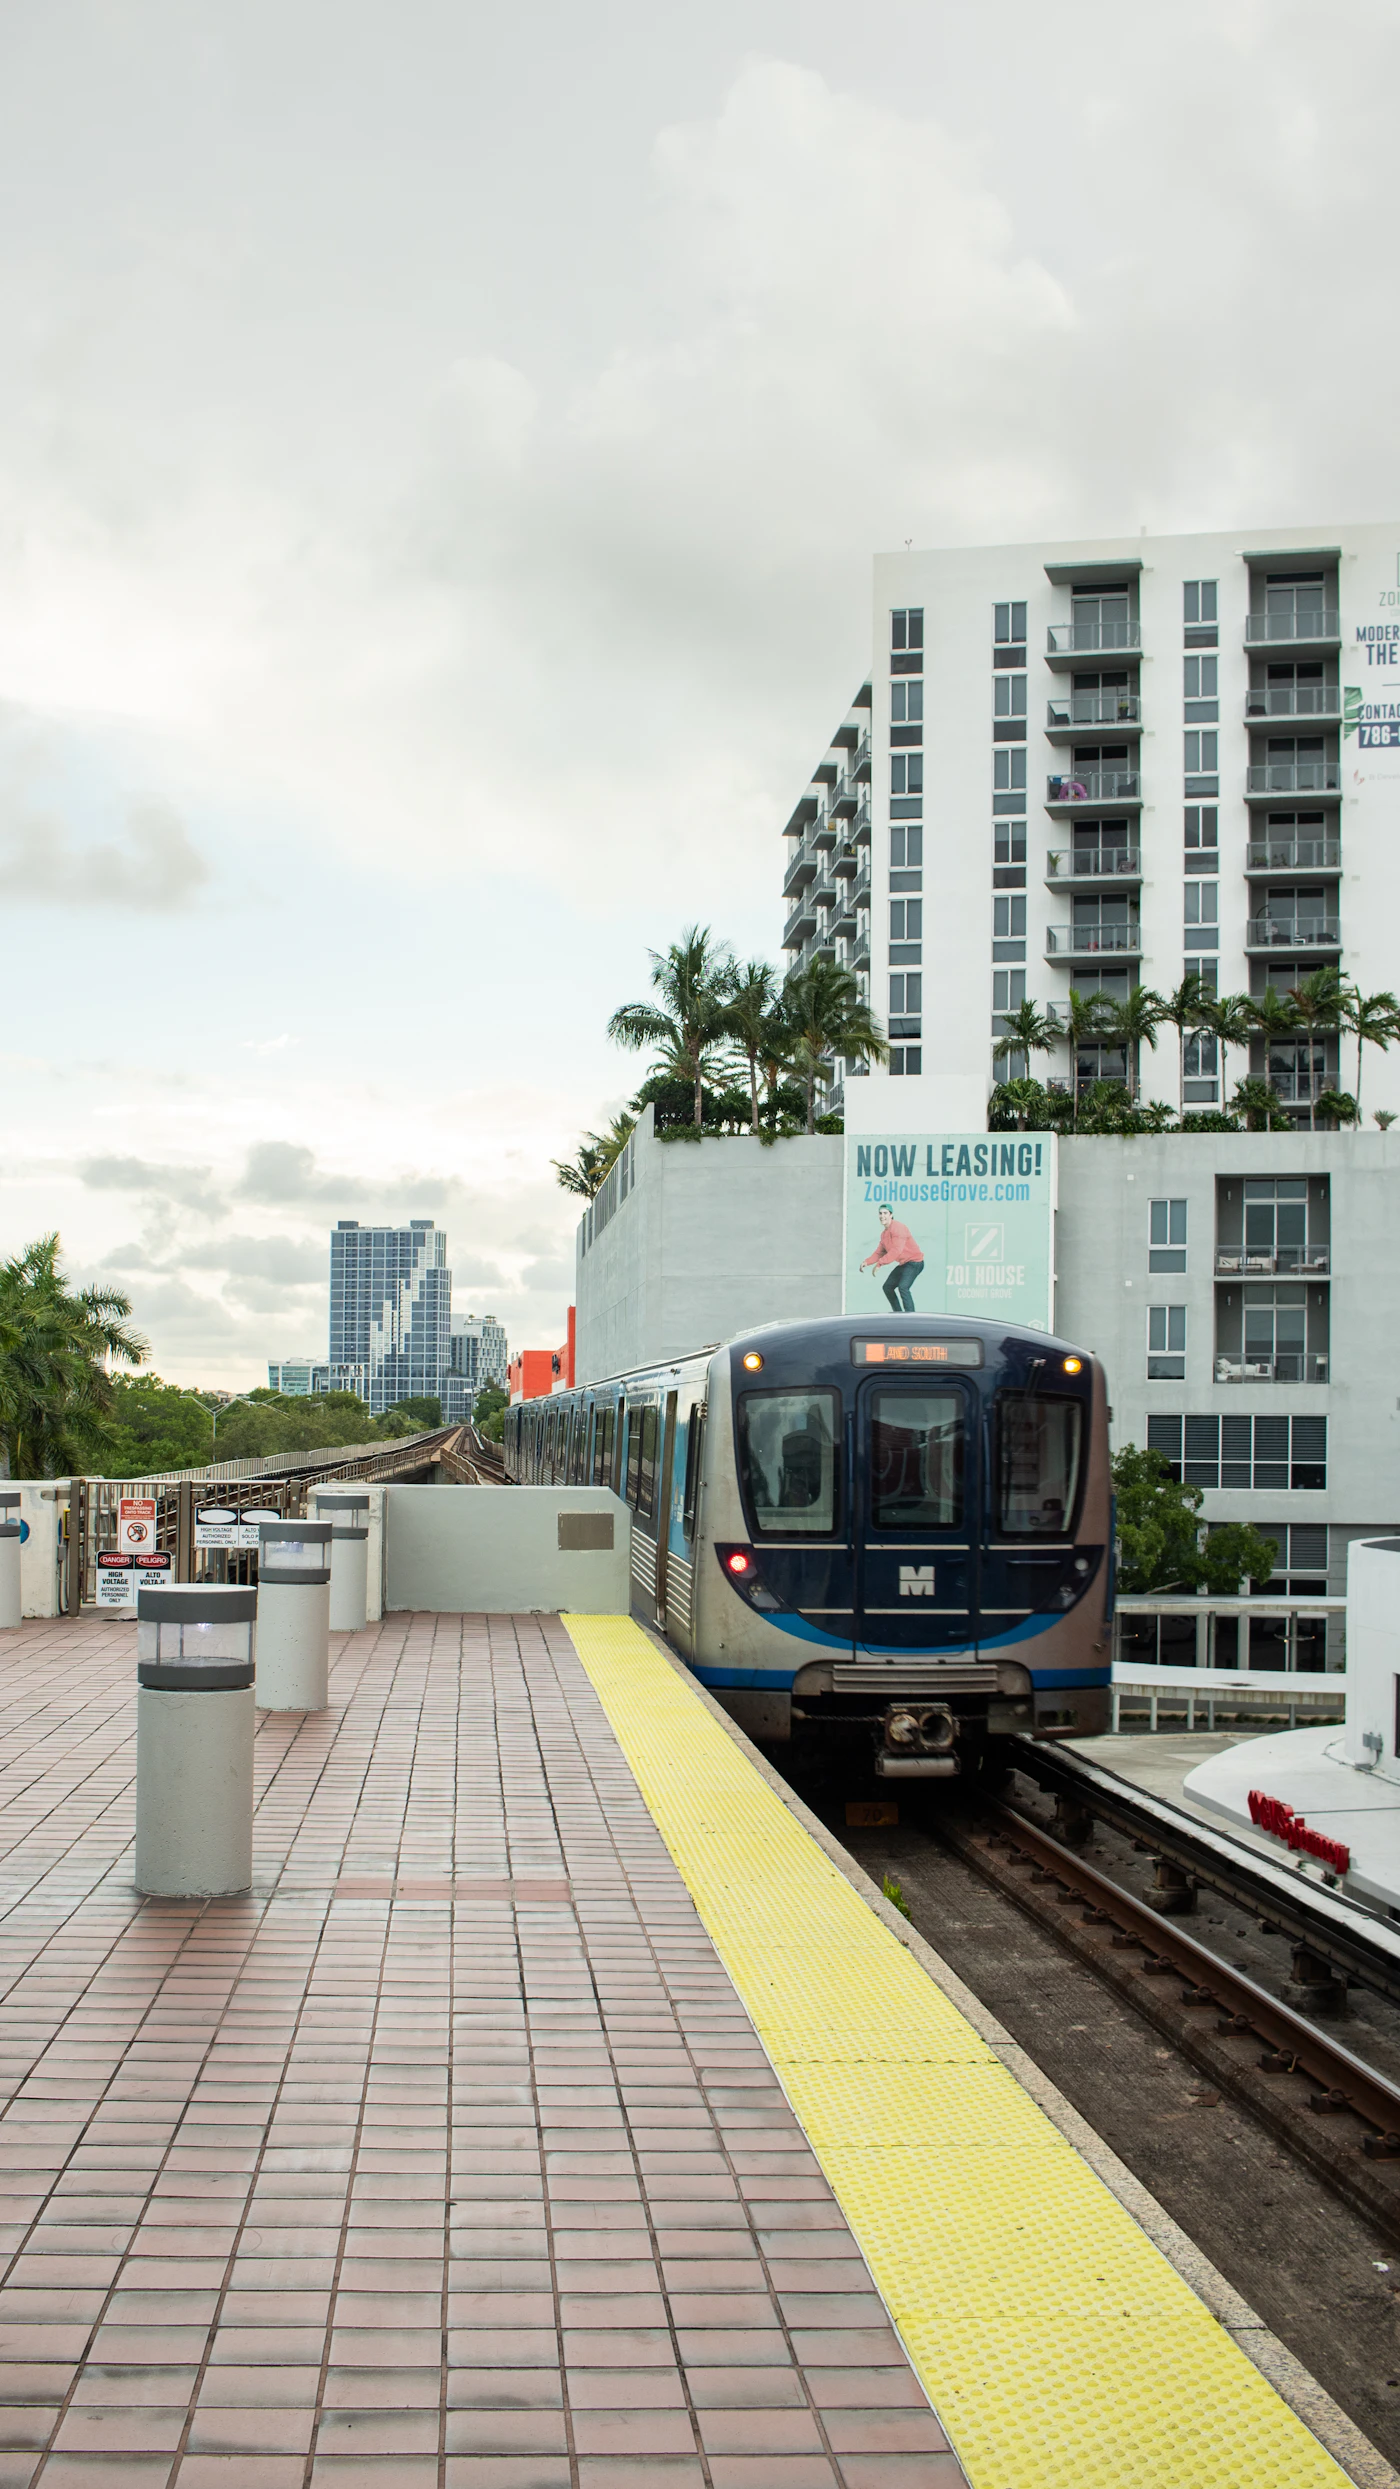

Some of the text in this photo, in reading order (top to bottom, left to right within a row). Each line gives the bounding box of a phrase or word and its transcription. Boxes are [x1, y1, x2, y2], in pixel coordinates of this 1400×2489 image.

[1365, 642, 1398, 666] THE
[1361, 725, 1400, 746] 786-
[857, 1143, 1042, 1177] NOW LEASING!
[864, 1180, 1030, 1202] ZoiHouseGrove.com
[946, 1265, 1025, 1286] ZOI HOUSE
[957, 1287, 1013, 1299] COCONUT GROVE
[911, 1346, 948, 1361] SOUTH
[863, 1808, 882, 1822] 70
